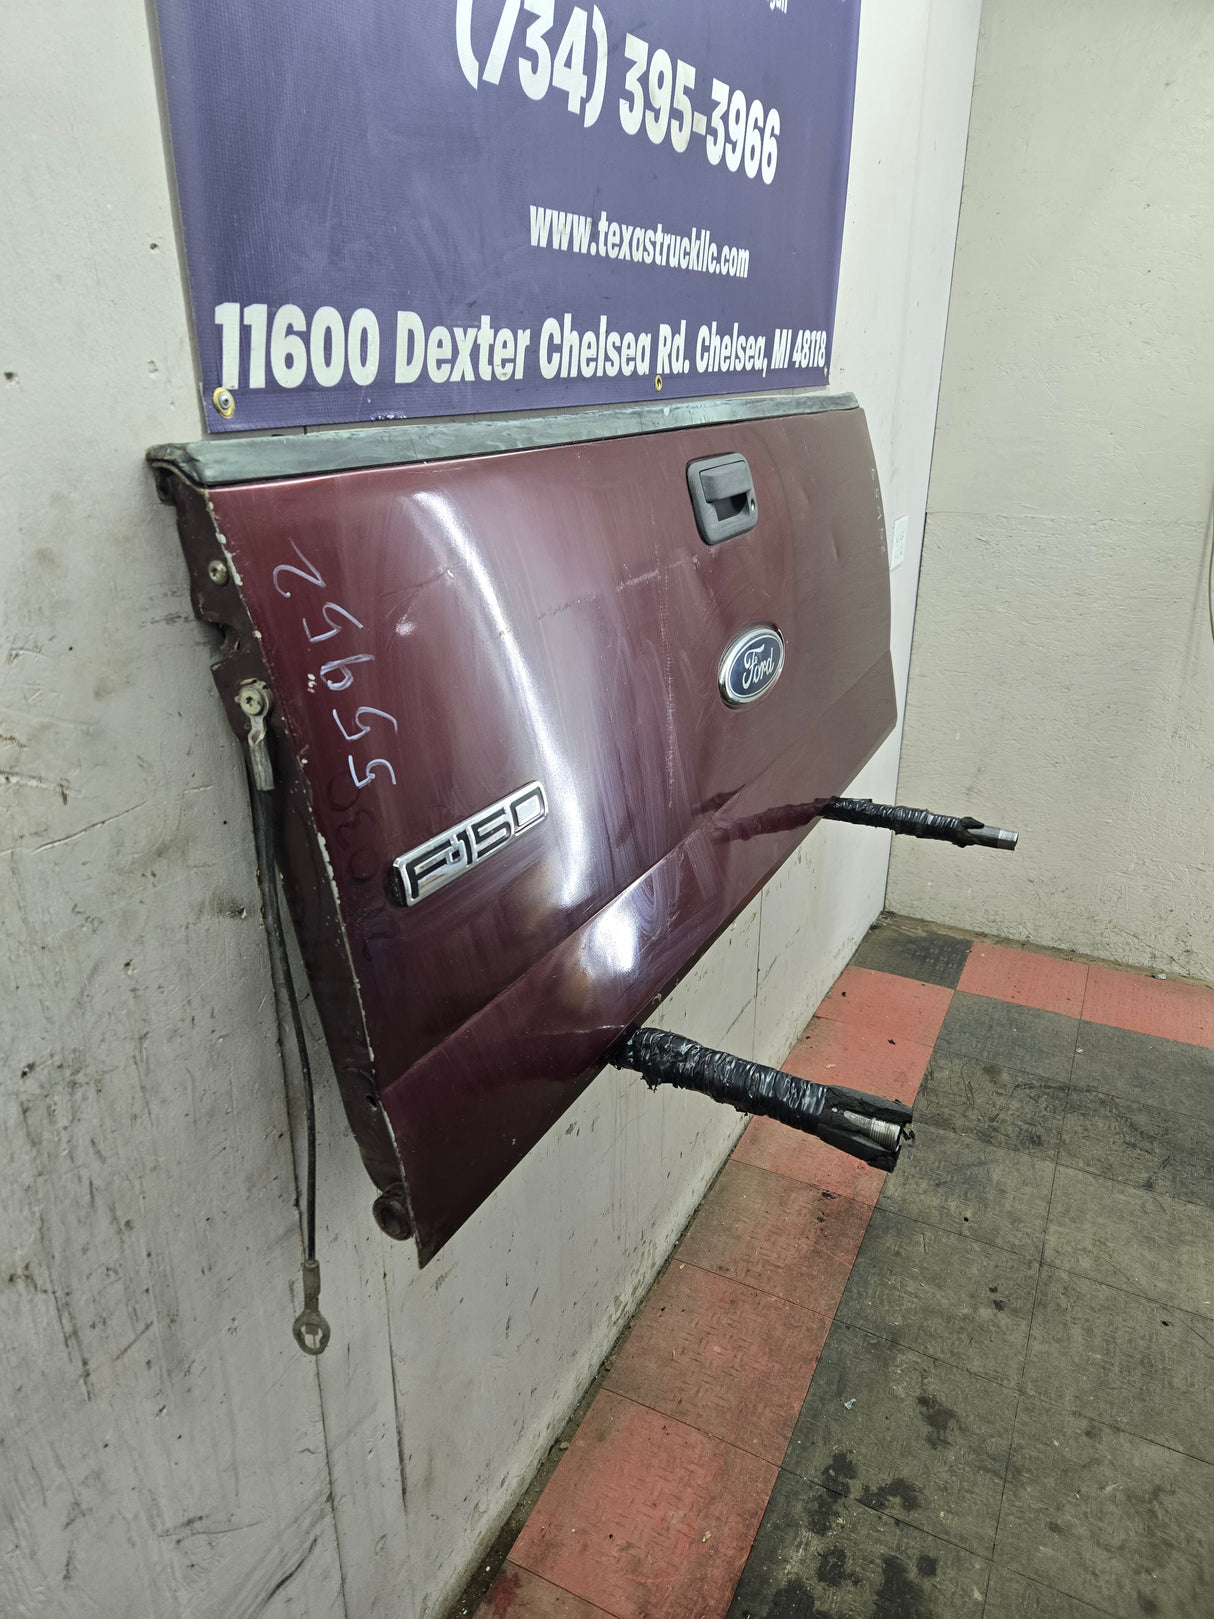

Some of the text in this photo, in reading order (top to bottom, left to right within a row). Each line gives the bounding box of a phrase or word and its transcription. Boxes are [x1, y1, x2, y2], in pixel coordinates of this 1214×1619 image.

[456, 0, 780, 185] (734) 395-3966
[529, 205, 750, 278] www.texastruckllc.com
[214, 302, 827, 390] 11600 Dexter Chelsea Rd. Chelsea, MI 48118
[742, 643, 775, 690] Ford
[405, 786, 546, 900] F-150
